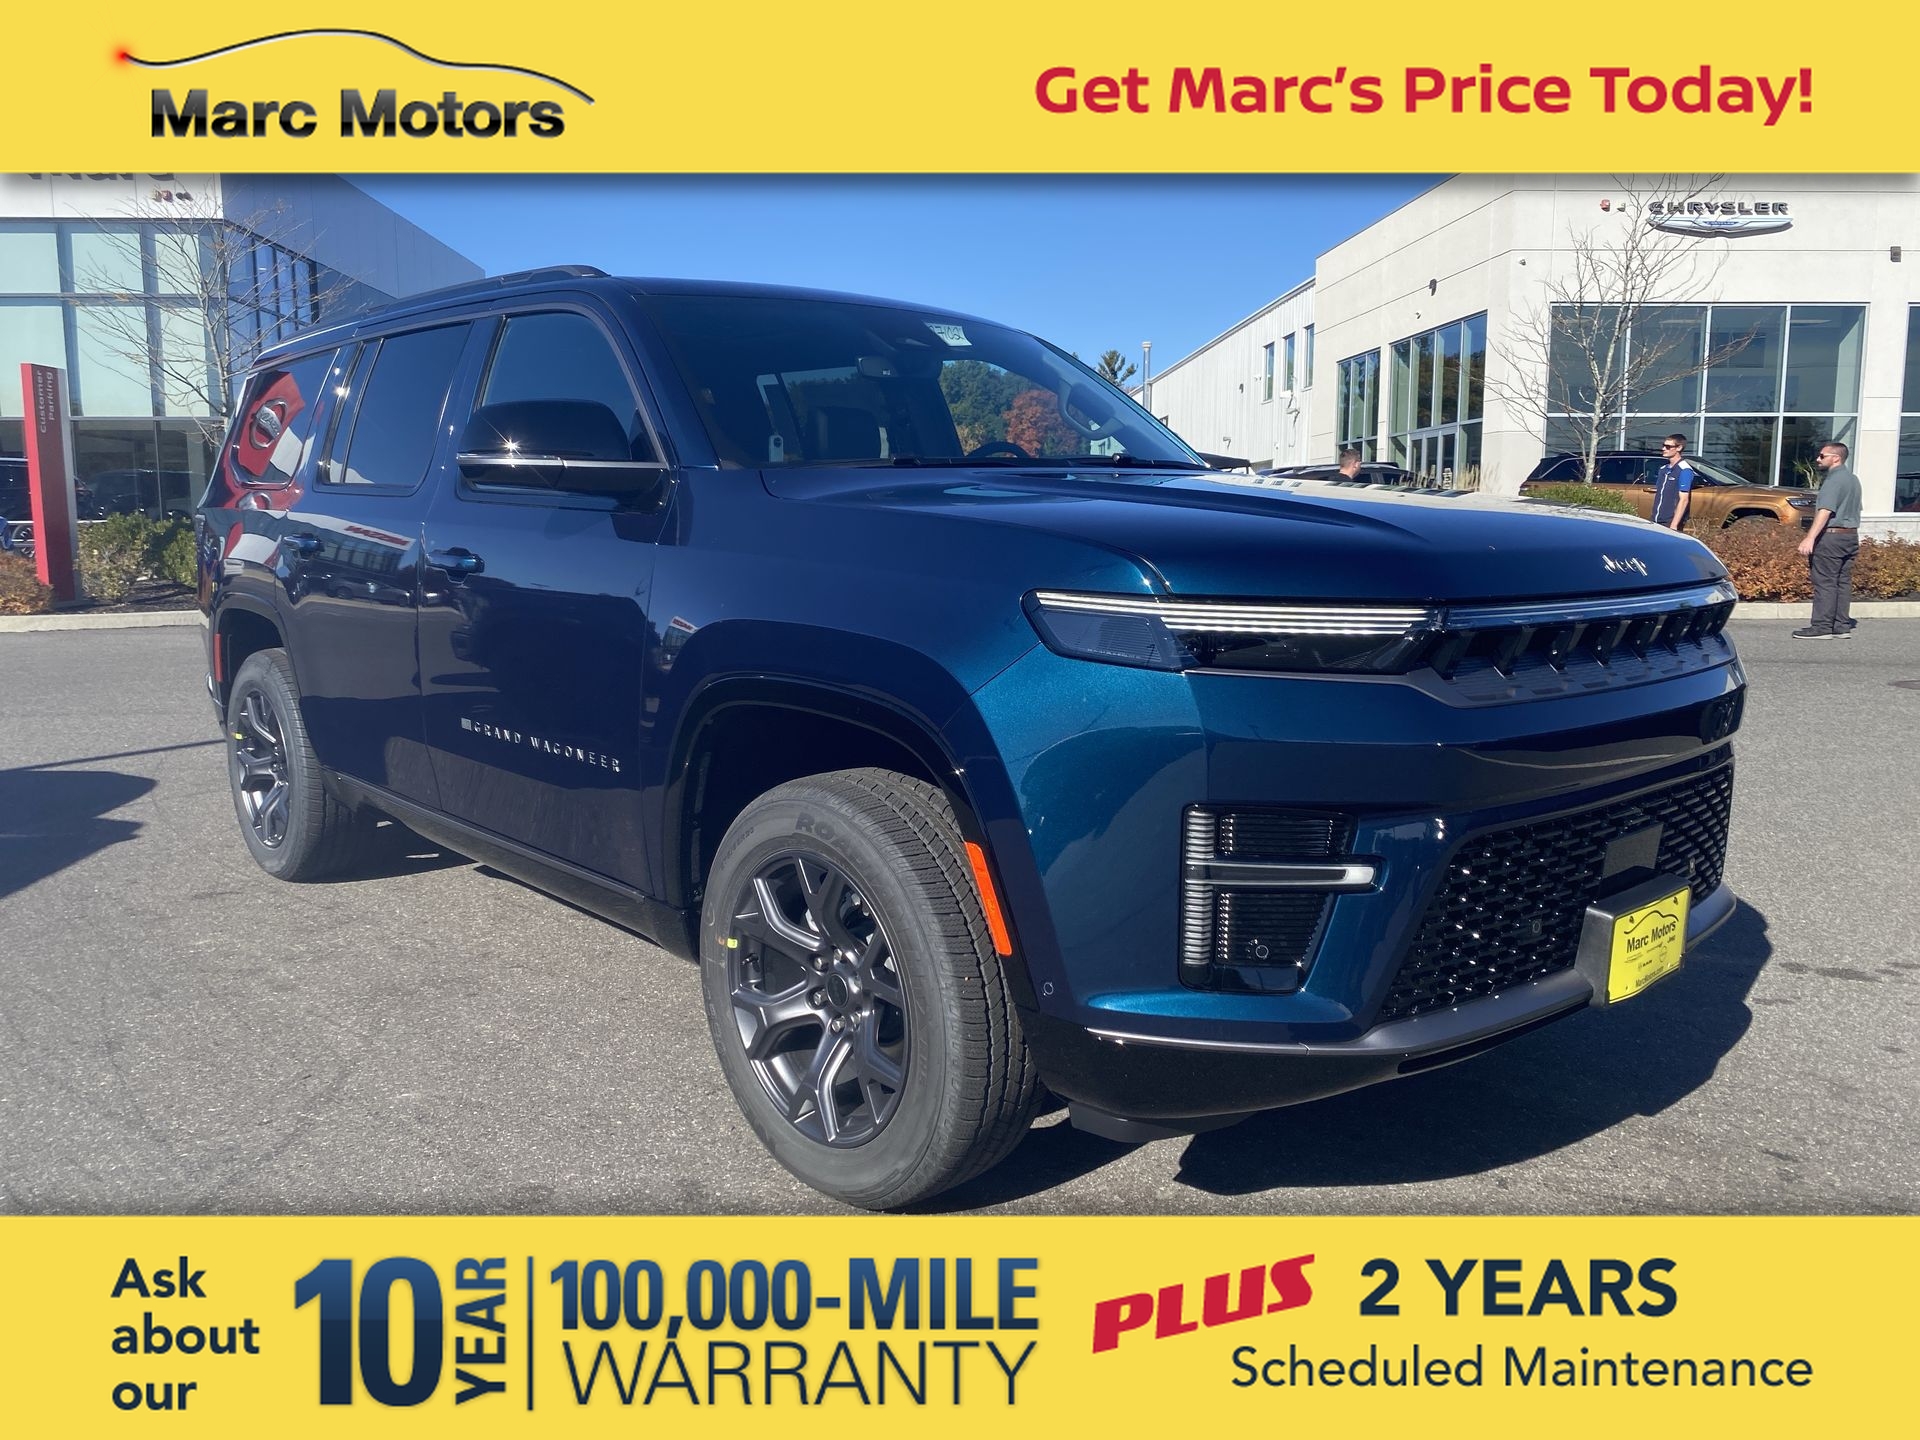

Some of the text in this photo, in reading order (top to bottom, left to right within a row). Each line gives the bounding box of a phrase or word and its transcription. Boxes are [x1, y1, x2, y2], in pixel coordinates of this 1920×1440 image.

[1649, 201, 1788, 215] CHRYSLER
[37, 369, 46, 434] Customer
[46, 371, 55, 421] Parking
[1602, 554, 1648, 577] Jeep
[474, 721, 621, 773] GRAND WAGONEER
[1626, 934, 1649, 954] Marc
[1651, 920, 1676, 943] Motors
